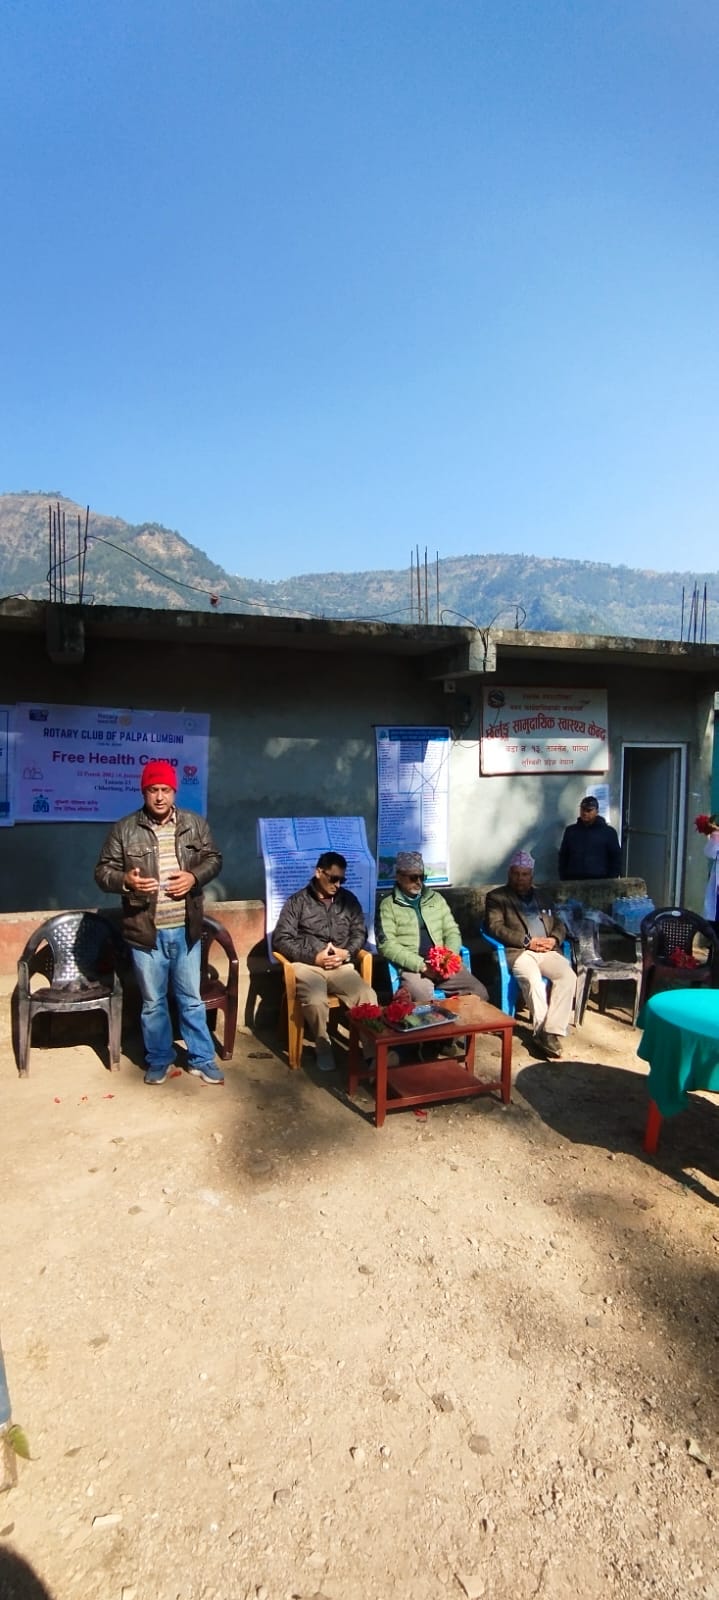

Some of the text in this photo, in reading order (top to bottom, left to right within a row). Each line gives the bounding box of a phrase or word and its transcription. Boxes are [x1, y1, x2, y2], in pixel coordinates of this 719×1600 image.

[43, 727, 184, 745] ROTARY CLUB OF PALPA LUMBINI
[52, 750, 179, 768] Free Health Camp
